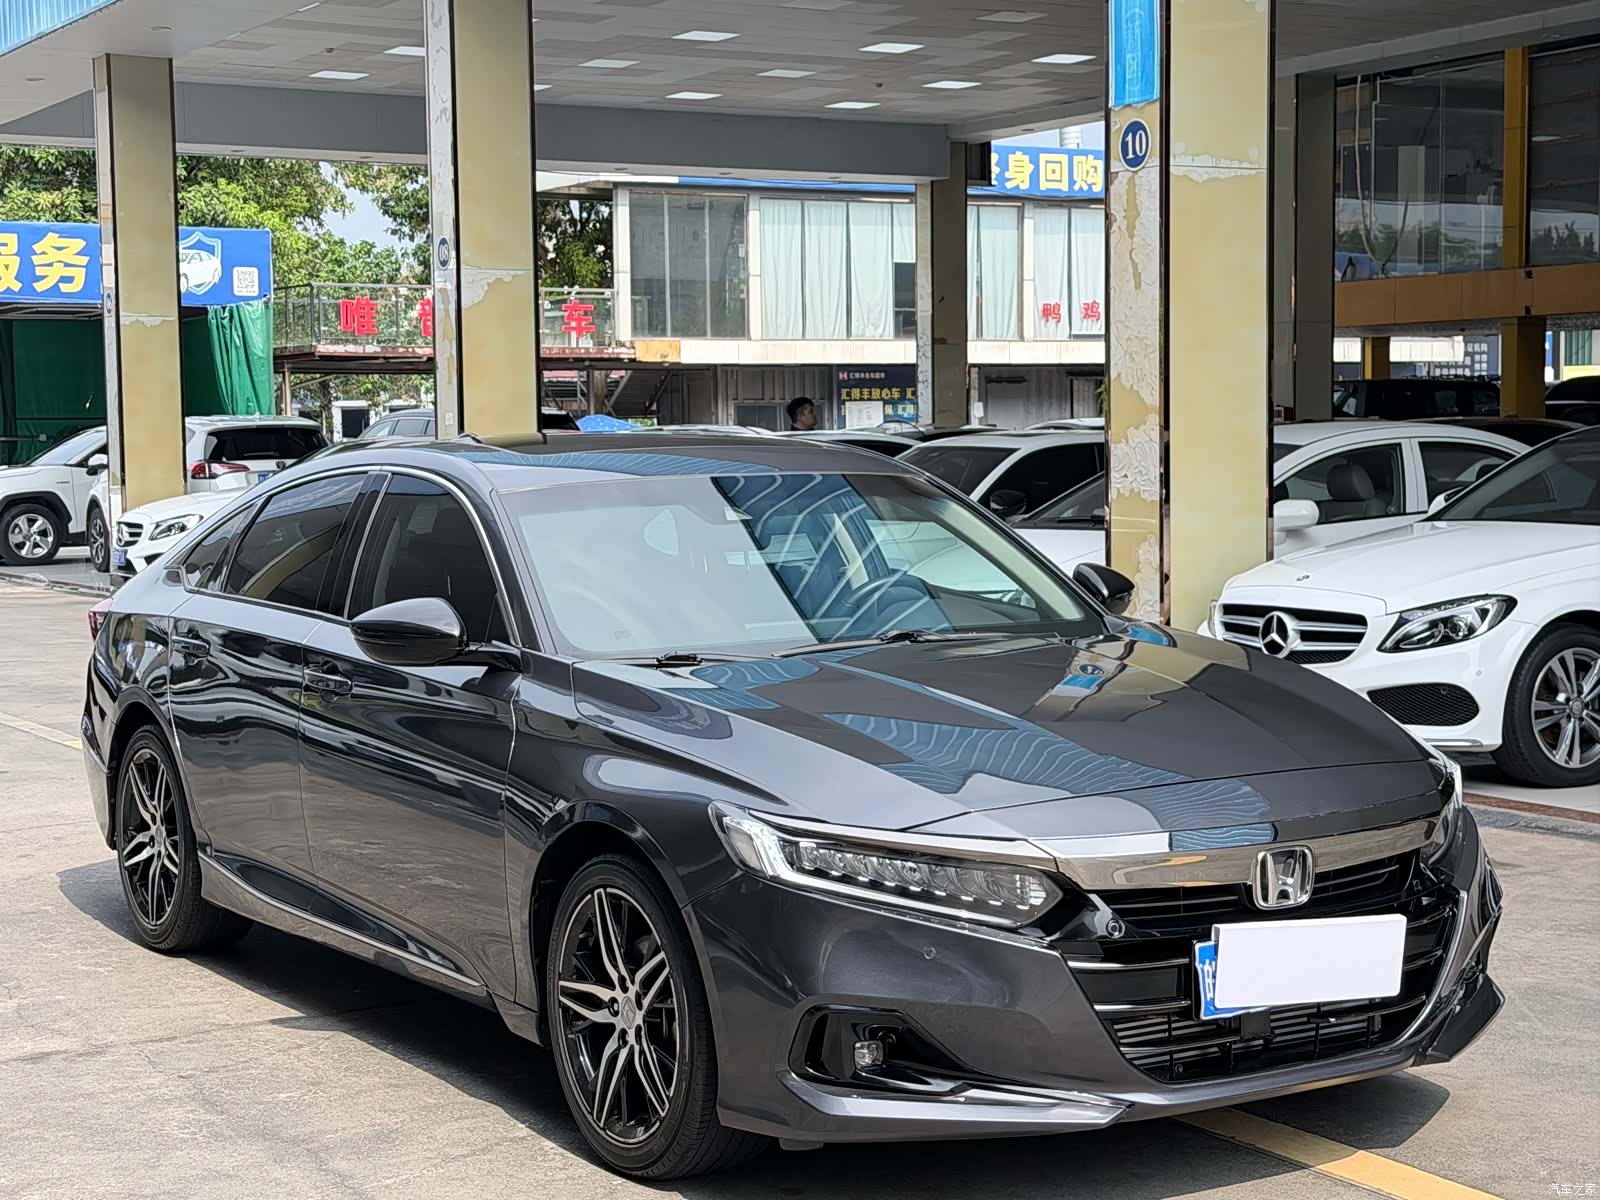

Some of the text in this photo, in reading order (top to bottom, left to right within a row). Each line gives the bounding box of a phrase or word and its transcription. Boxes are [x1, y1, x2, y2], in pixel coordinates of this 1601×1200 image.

[1125, 129, 1147, 161] 10
[440, 243, 449, 262] 08
[562, 299, 596, 338] 车
[1082, 299, 1101, 322] 鸡
[841, 387, 901, 400] 汇得丰放心车
